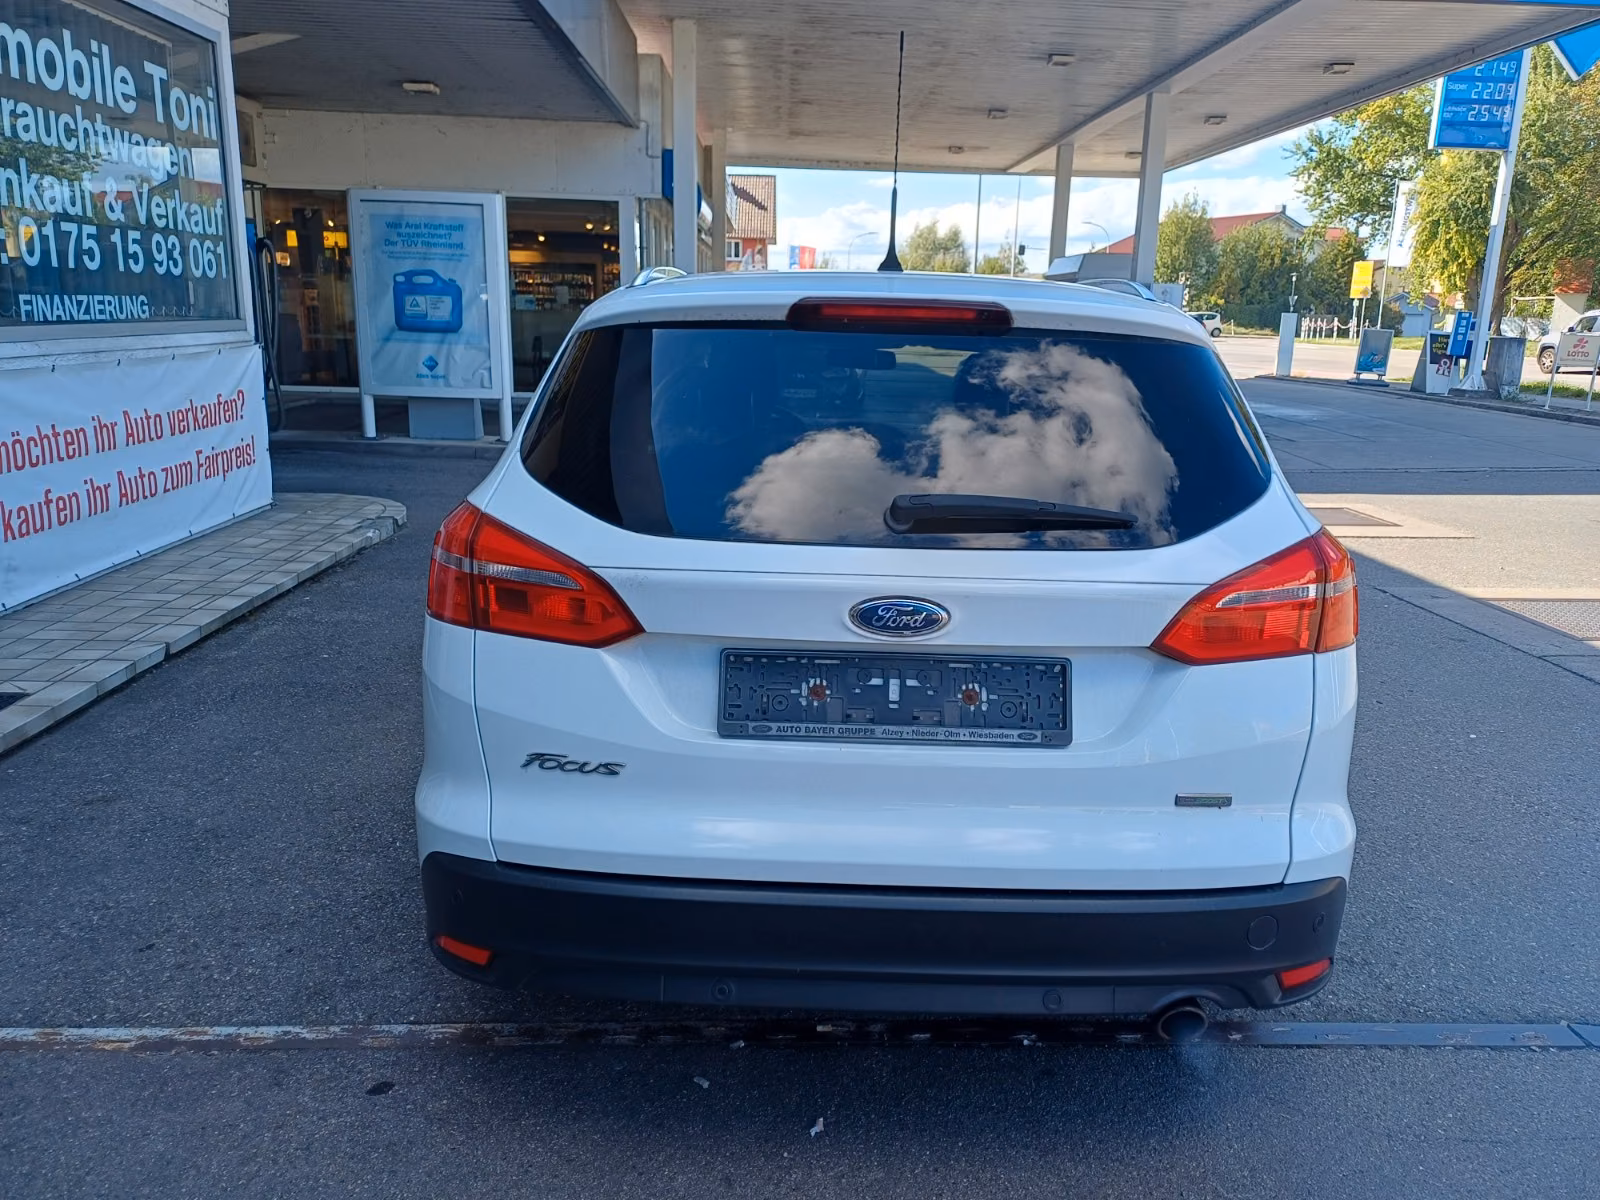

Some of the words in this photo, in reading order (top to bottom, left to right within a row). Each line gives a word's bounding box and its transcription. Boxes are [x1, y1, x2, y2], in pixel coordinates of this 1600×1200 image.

[1448, 82, 1468, 91] Super
[144, 60, 217, 140] Toni
[104, 176, 125, 222] &
[131, 183, 225, 237] Verkauf
[385, 221, 403, 230] Was
[404, 221, 422, 230] Aral
[423, 222, 464, 232] Kraftstoff
[396, 231, 453, 241] auszeichnet?
[110, 228, 145, 274] 15
[151, 232, 183, 277] 93
[189, 238, 228, 280] 061
[384, 238, 399, 247] Der
[400, 238, 419, 248] TÜV
[19, 294, 150, 321] FINANZIERUNG
[1567, 350, 1590, 358] LOTTO
[0, 423, 90, 475] möchten
[91, 414, 117, 454] ihr
[122, 407, 164, 448] Auto
[166, 388, 246, 438] verkaufen?
[0, 488, 82, 543] kaufen
[83, 477, 111, 518] ihr
[116, 466, 158, 508] Auto
[160, 459, 193, 494] zum
[195, 434, 256, 483] Fairpreis!
[872, 605, 927, 627] Ford
[775, 725, 804, 735] AUTO
[804, 726, 835, 735] BAYER
[837, 727, 876, 736] GRUPPE
[881, 728, 904, 738] Alzey
[968, 730, 1015, 741] Wiesbaden
